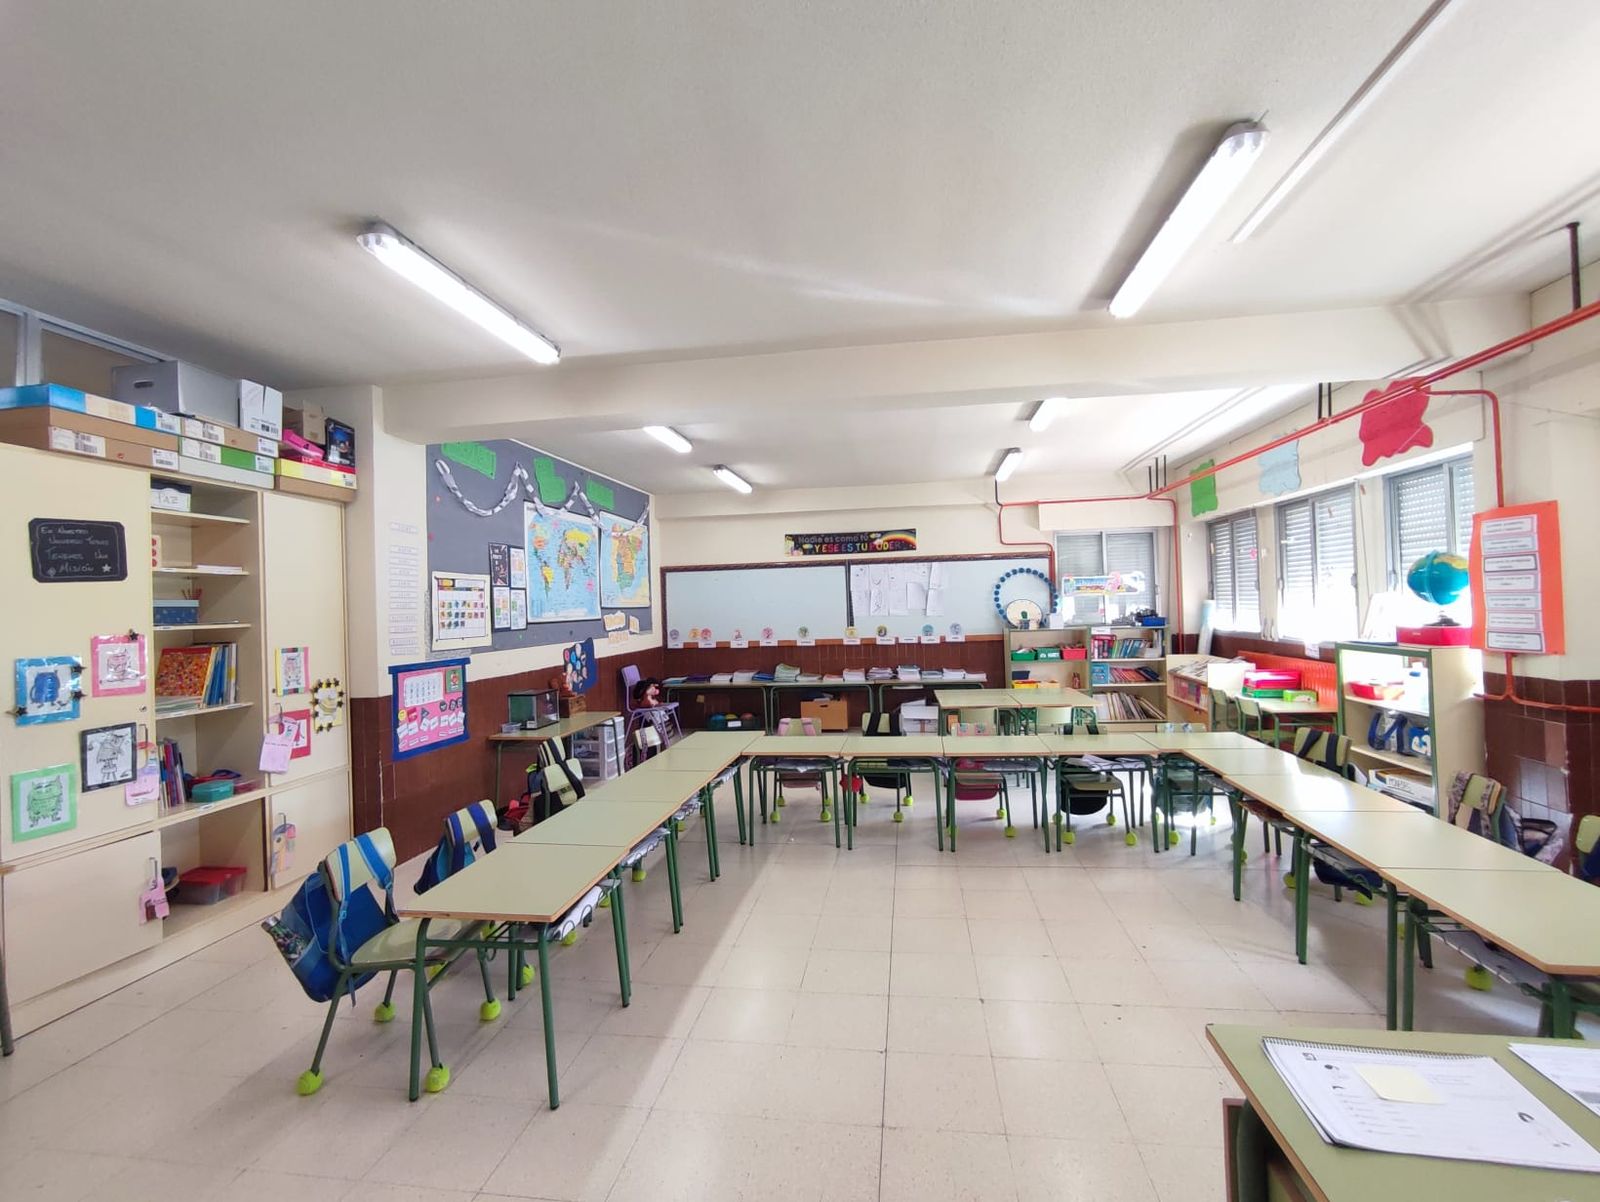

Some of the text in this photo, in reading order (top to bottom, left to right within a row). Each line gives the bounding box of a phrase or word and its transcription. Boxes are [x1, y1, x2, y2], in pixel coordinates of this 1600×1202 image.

[798, 536, 823, 544] Nadie
[841, 543, 854, 552] ES
[855, 543, 868, 551] TU
[869, 541, 902, 551] PODER
